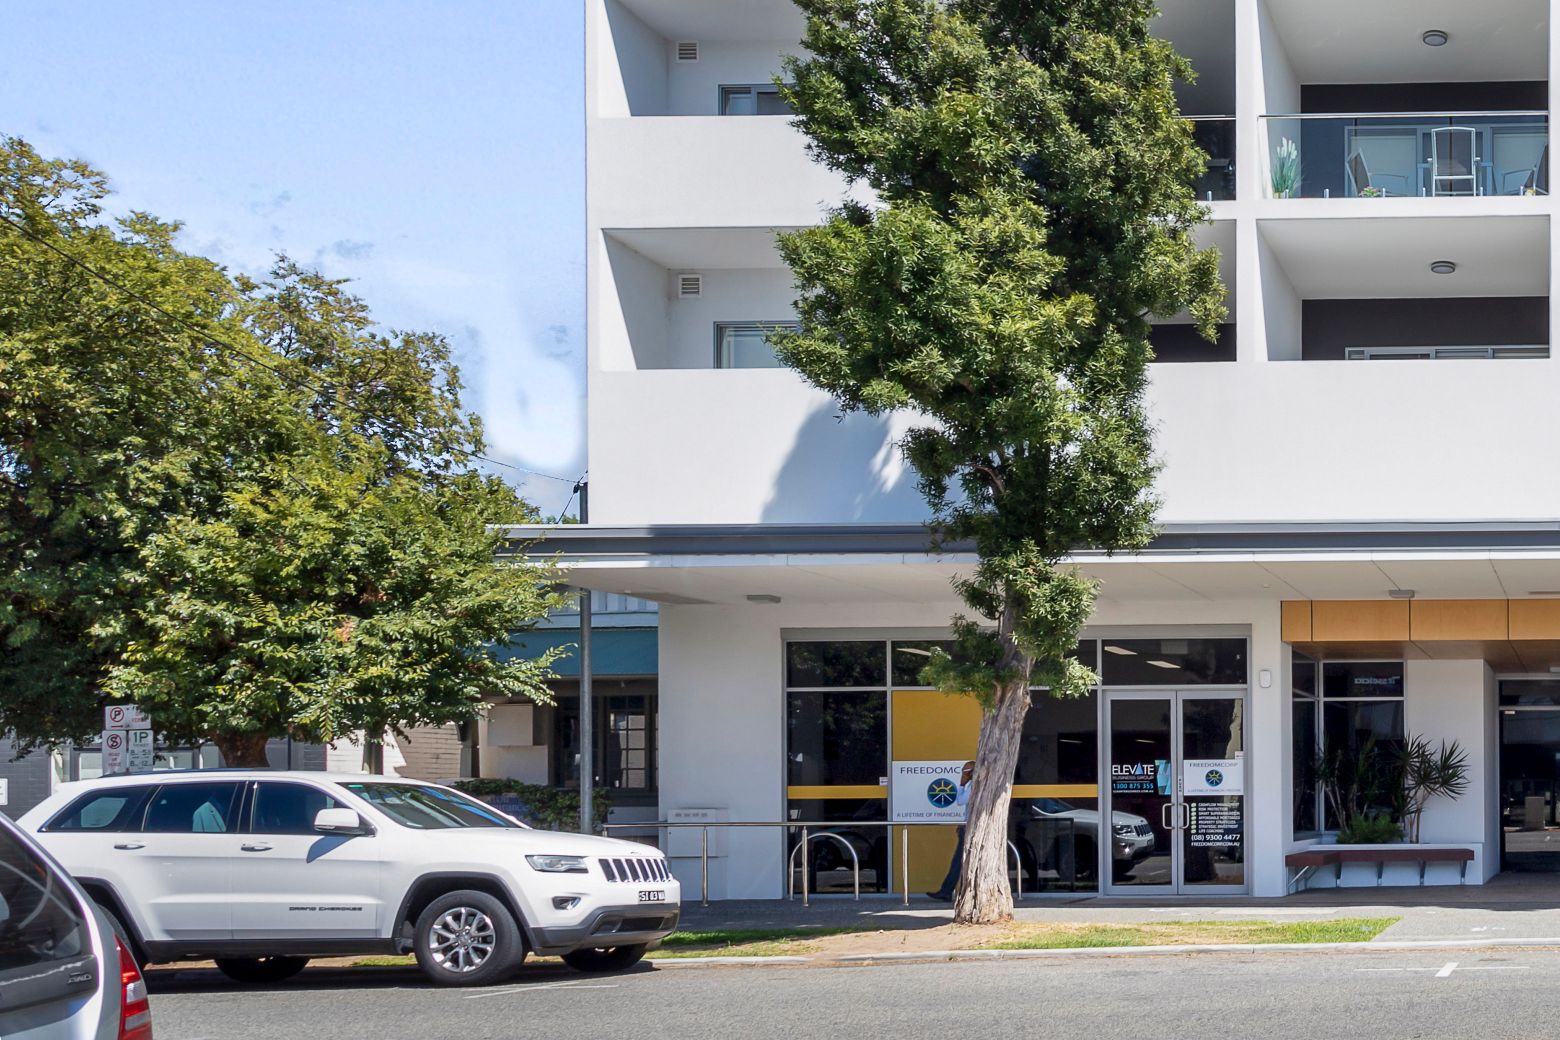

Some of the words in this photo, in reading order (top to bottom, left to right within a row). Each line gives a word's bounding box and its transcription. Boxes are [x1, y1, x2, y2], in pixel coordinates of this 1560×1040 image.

[133, 732, 149, 743] 1P
[900, 766, 961, 775] FREEDOMC
[1112, 763, 1154, 775] ELEVATE
